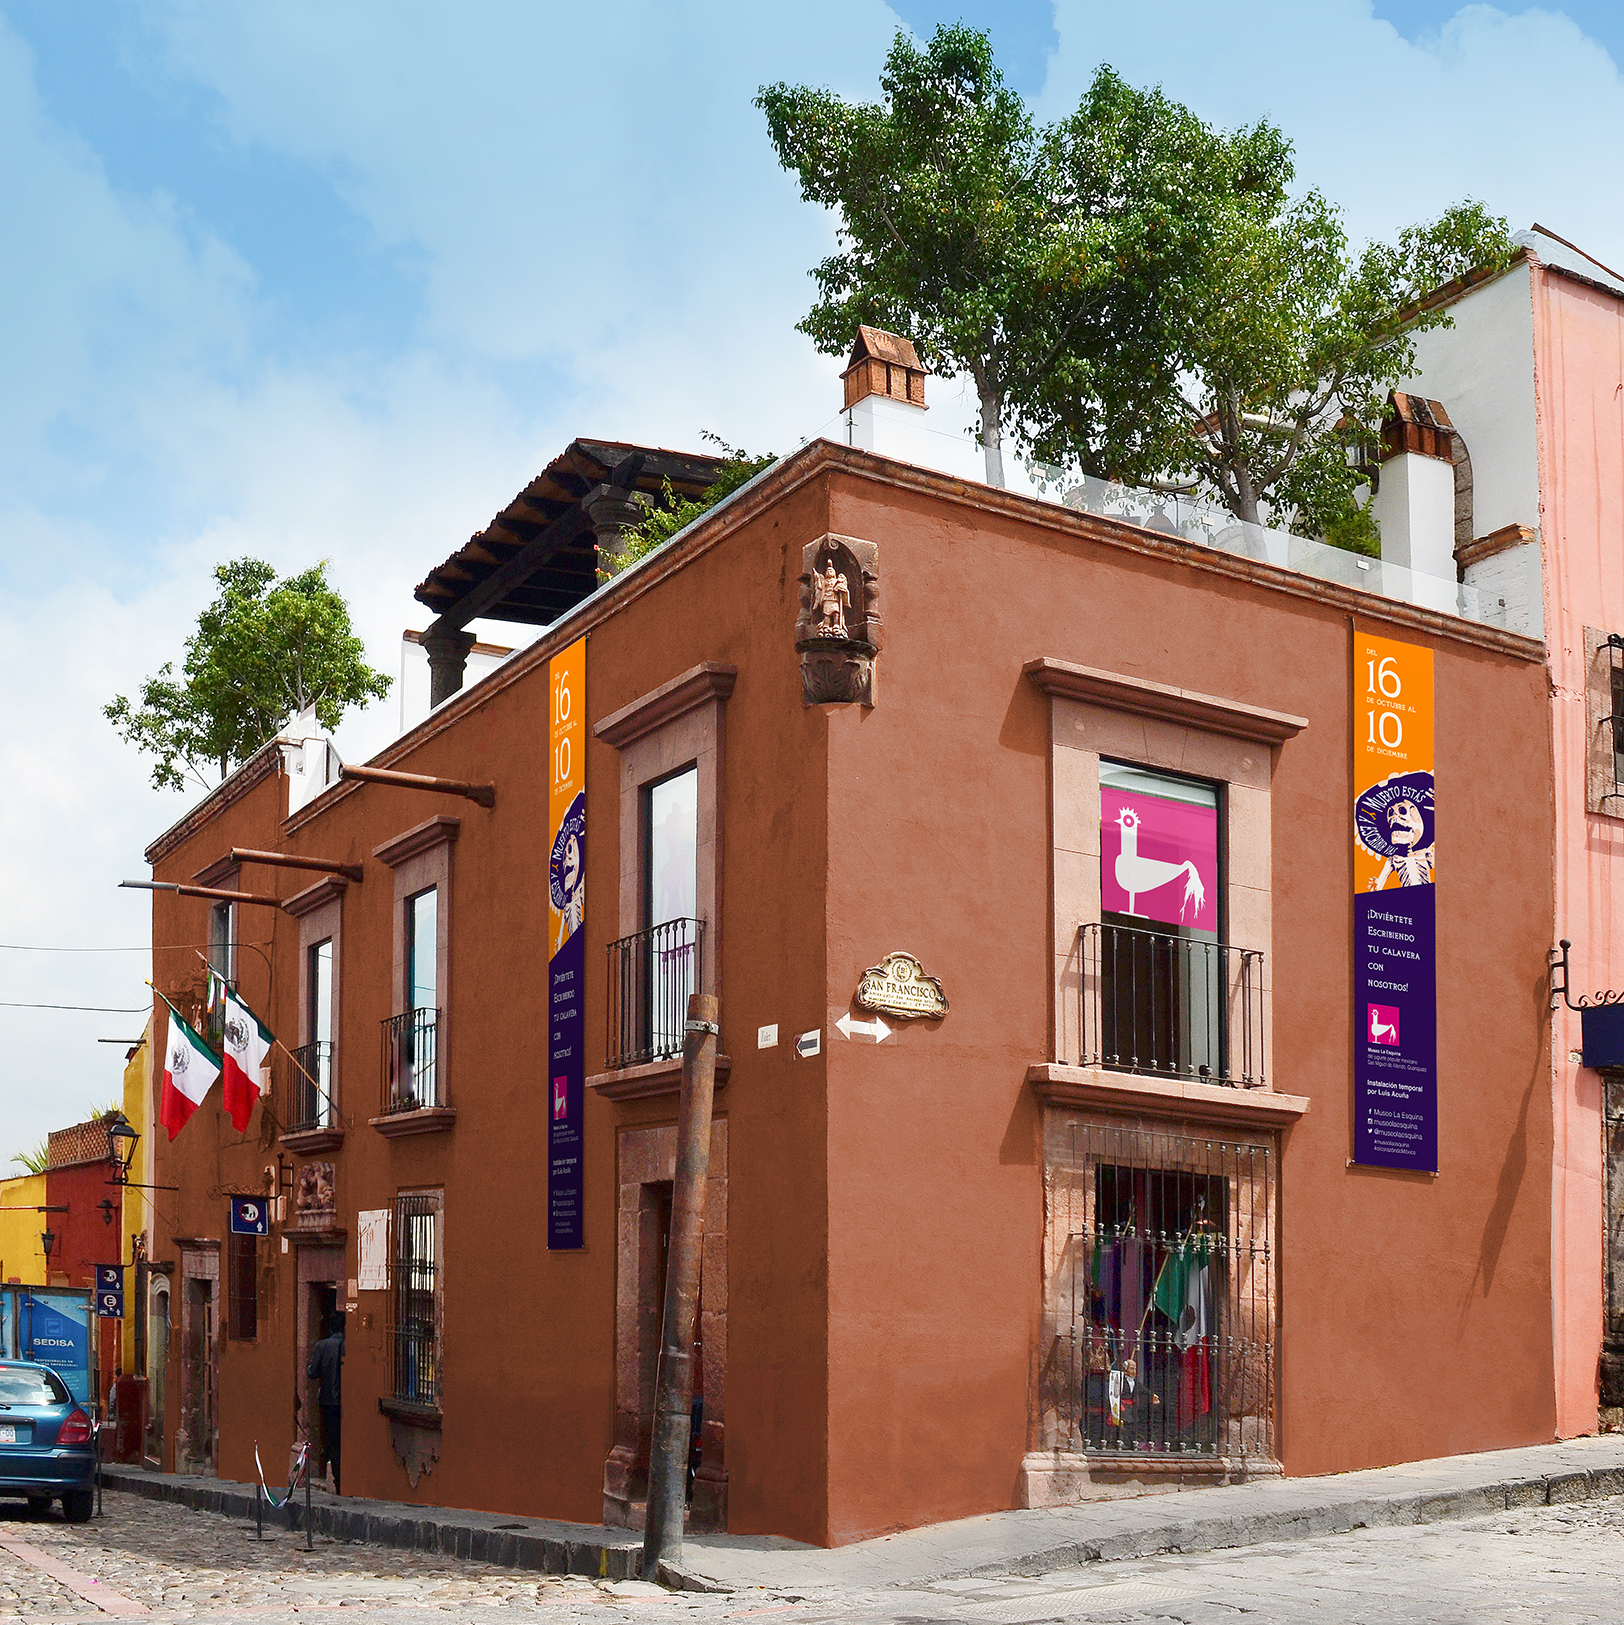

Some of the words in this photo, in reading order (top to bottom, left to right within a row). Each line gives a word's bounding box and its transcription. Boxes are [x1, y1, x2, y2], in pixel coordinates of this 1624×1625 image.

[1366, 648, 1378, 656] DEL
[1366, 657, 1402, 698] 16
[554, 670, 571, 726] 16
[1376, 699, 1406, 711] OCTUBRE
[1366, 710, 1403, 748] 10
[1366, 745, 1375, 753] DE
[1376, 747, 1408, 760] DICIEMBRE
[554, 737, 571, 785] 10
[1362, 785, 1401, 813] MUERTO
[1402, 785, 1427, 803] ESTÁS
[866, 979, 884, 991] SAN
[886, 982, 937, 999] FRANCISCO
[1367, 1079, 1398, 1089] Instalación
[1398, 1083, 1423, 1092] temporal
[1378, 1089, 1391, 1097] Luis
[1391, 1091, 1410, 1099] Acuña
[1393, 1111, 1401, 1119] La
[1401, 1111, 1424, 1121] Esquina
[33, 1338, 75, 1347] SEDISA
